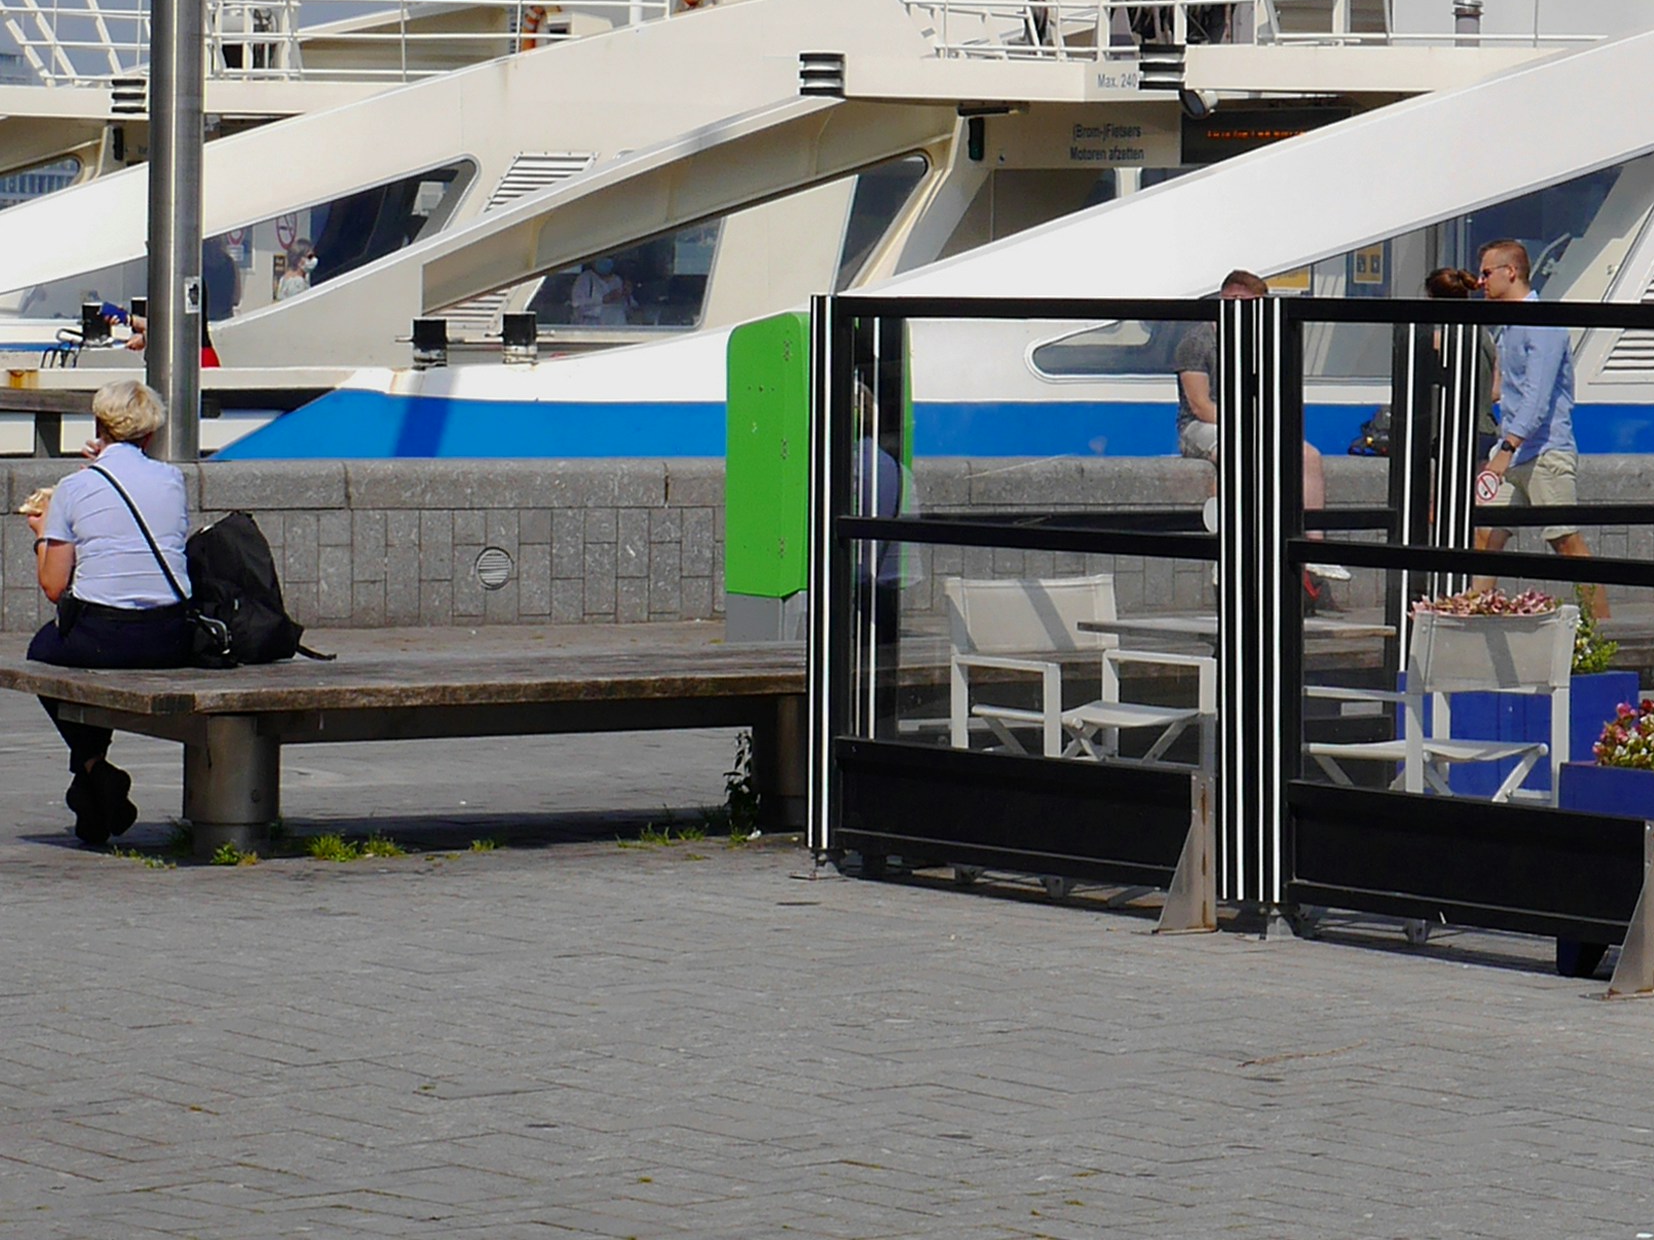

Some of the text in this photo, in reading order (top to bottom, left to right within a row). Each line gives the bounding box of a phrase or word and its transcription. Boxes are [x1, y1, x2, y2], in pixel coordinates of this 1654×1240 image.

[1097, 73, 1137, 88] Max. 240
[1070, 145, 1144, 160] Motoren afzetten
